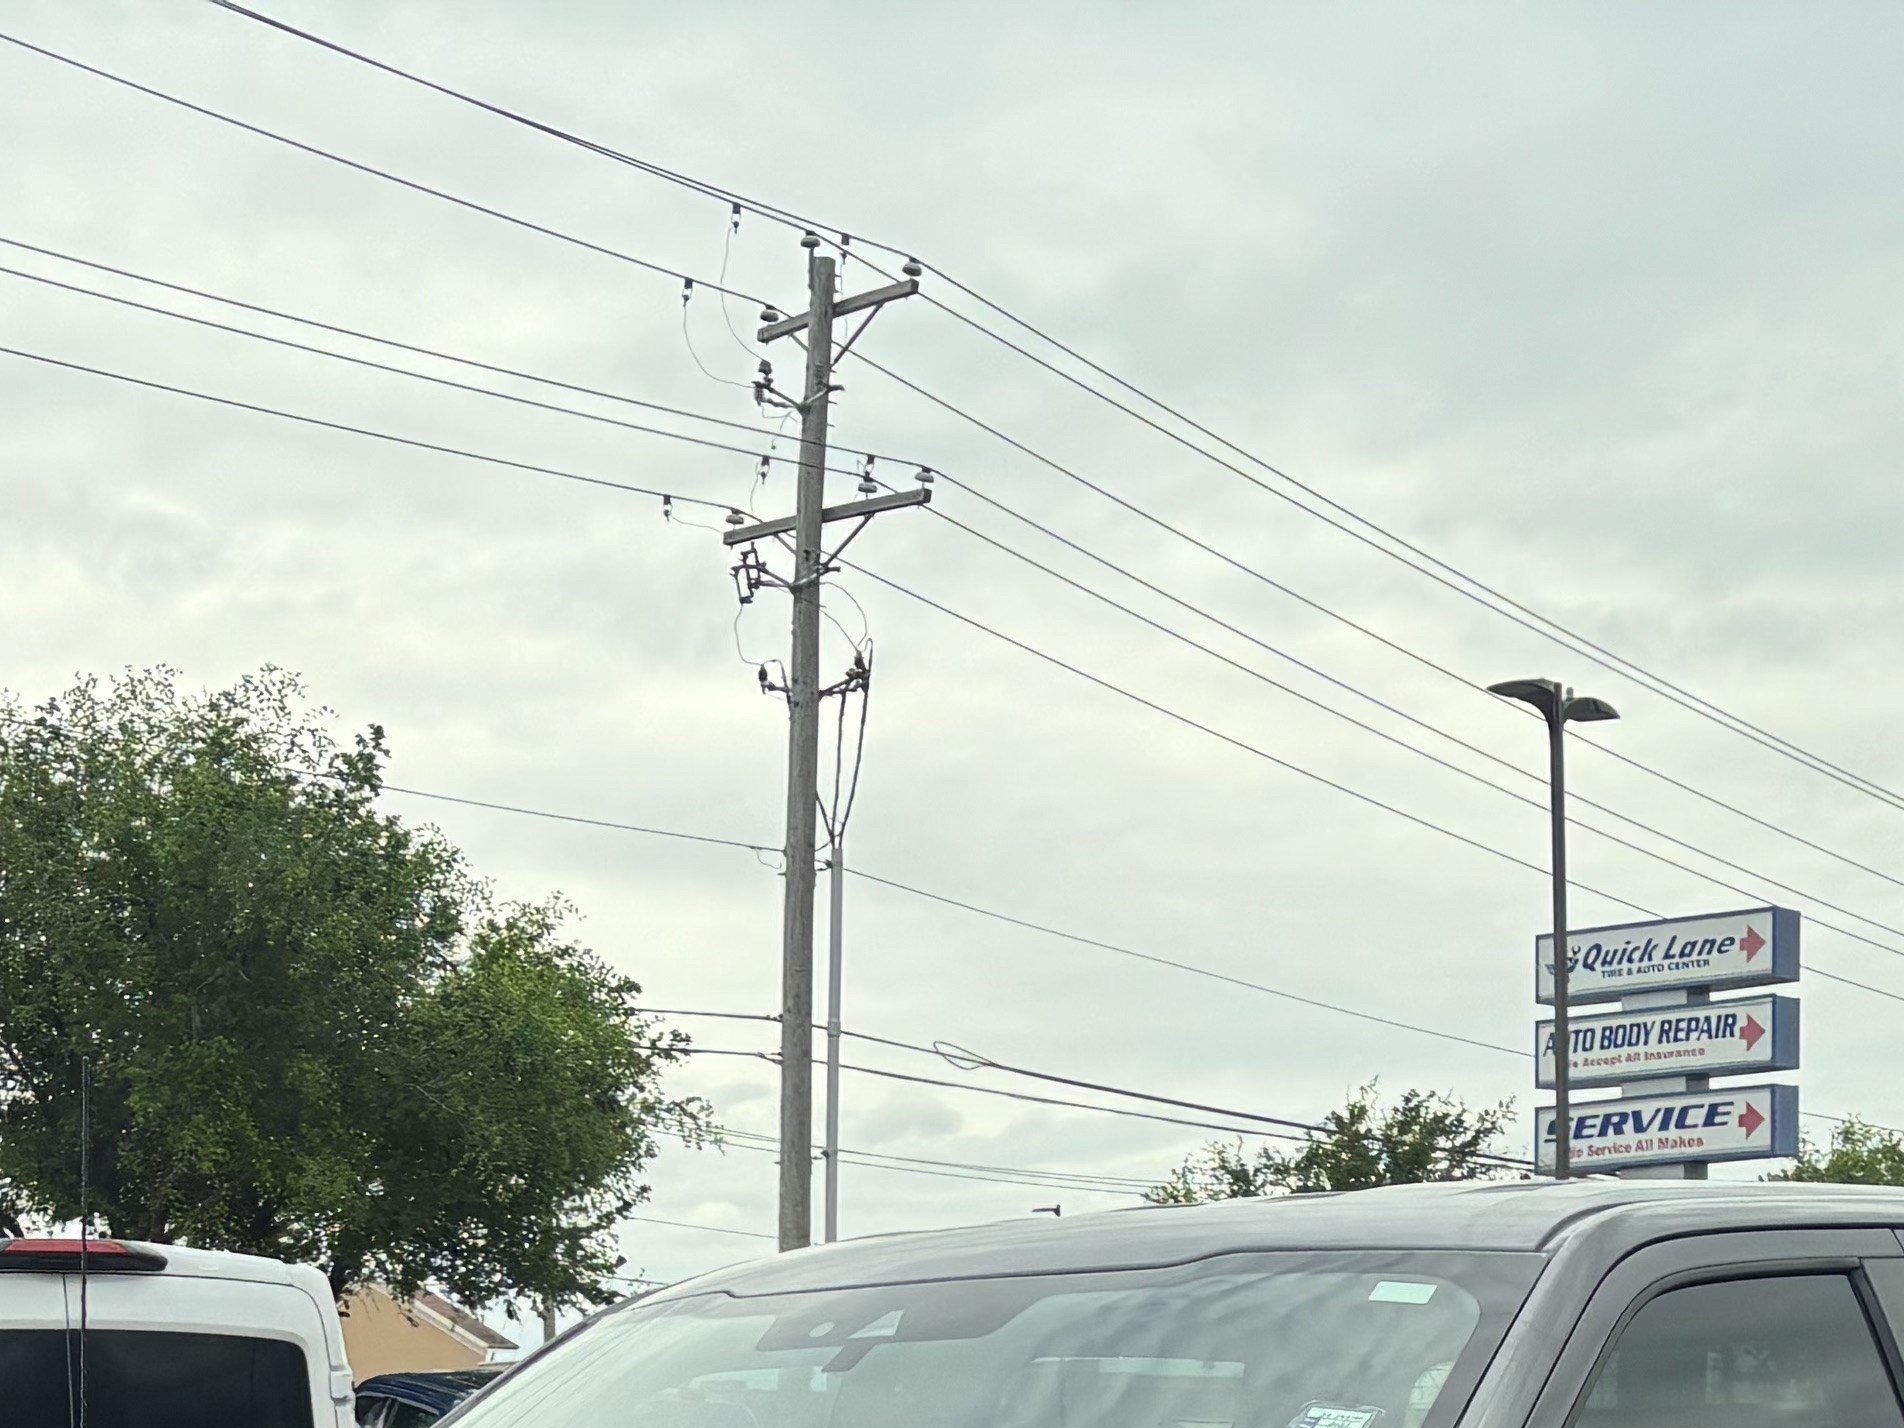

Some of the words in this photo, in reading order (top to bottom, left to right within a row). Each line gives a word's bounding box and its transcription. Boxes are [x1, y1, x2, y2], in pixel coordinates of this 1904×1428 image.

[1582, 937, 1659, 972] Quick
[1663, 935, 1736, 961] Lane
[1601, 968, 1623, 979] TIRE
[1636, 963, 1665, 975] AUTO
[1667, 958, 1711, 971] CENTER
[1543, 1028, 1596, 1057] ATO
[1599, 1020, 1657, 1051] BODY
[1657, 1013, 1738, 1045] REPAIR
[1587, 1144, 1632, 1158] Service
[1635, 1139, 1653, 1152] All
[1657, 1136, 1704, 1150] Makes
